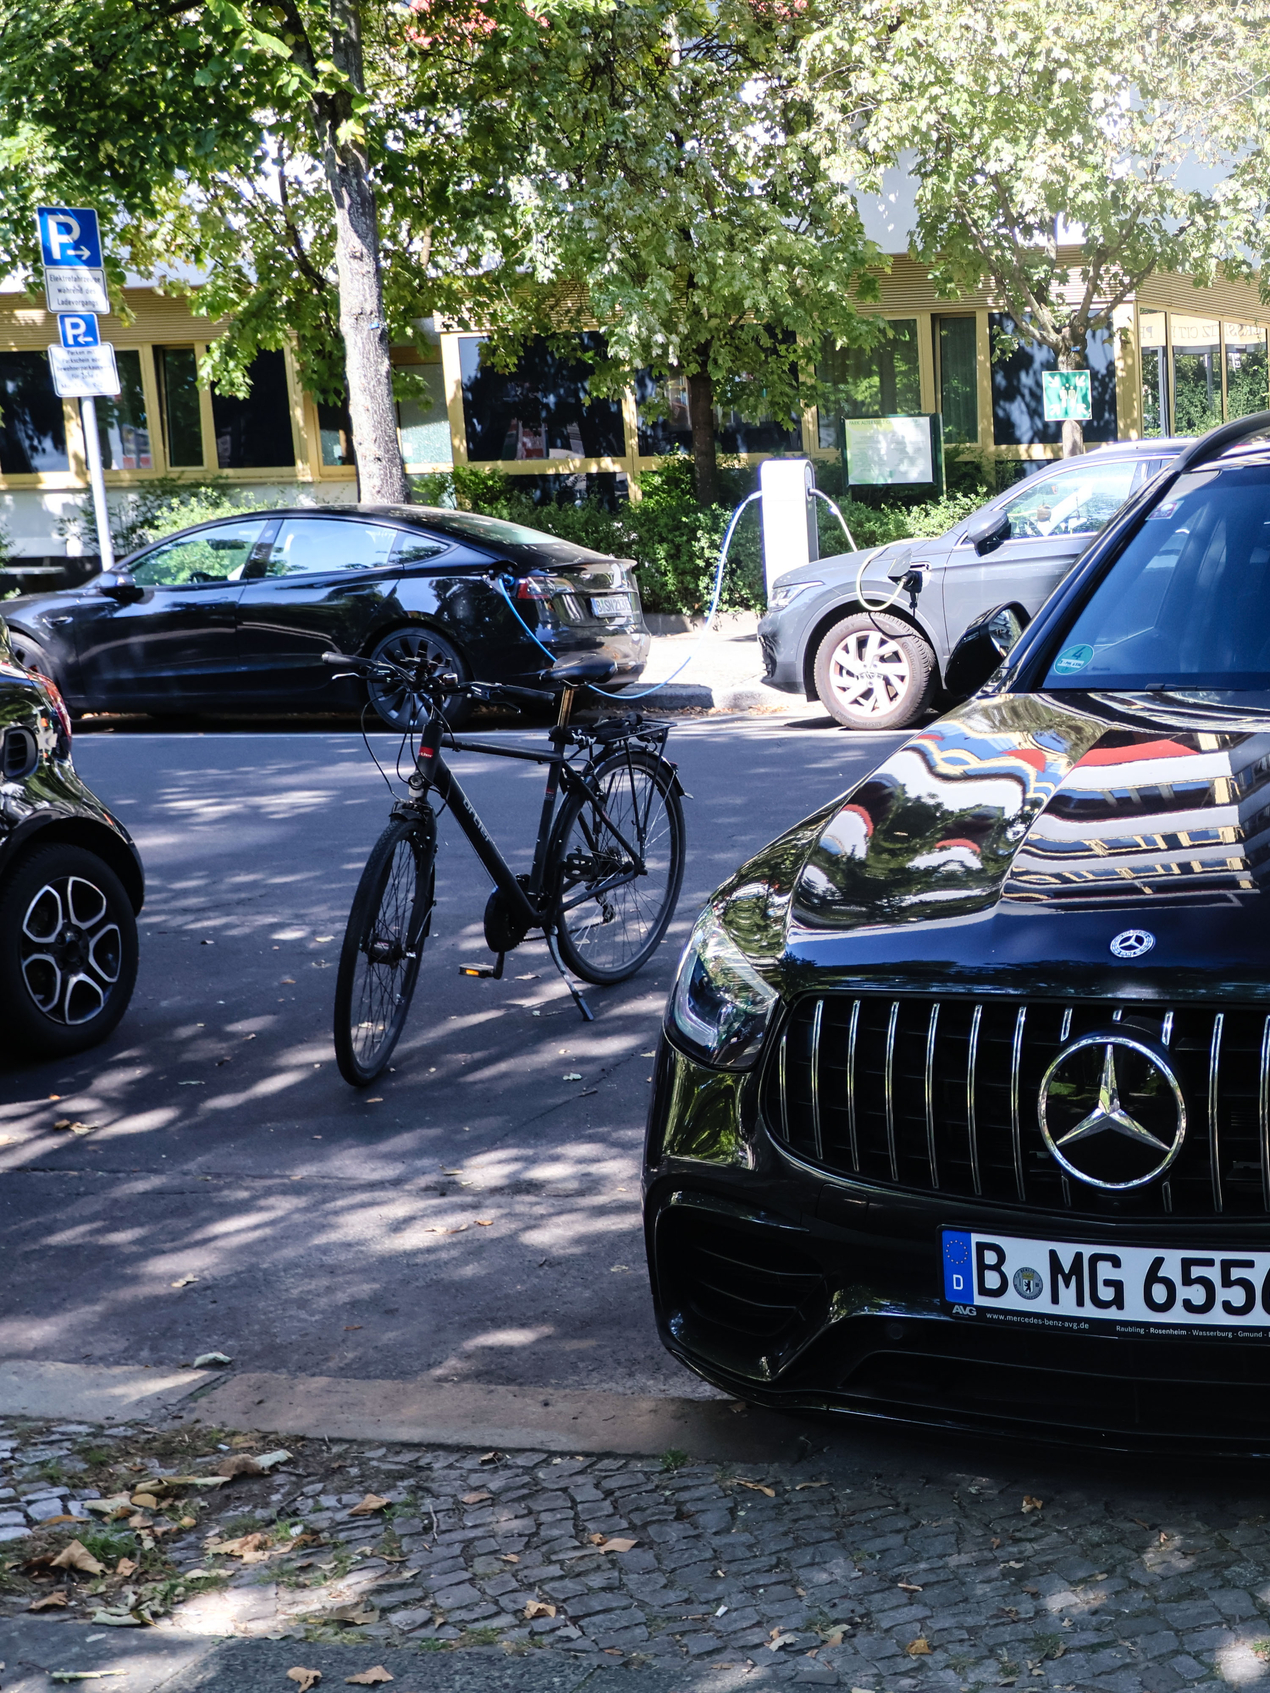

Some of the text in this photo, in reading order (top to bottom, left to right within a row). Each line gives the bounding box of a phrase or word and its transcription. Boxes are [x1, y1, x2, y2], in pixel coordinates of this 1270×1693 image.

[48, 215, 80, 260] P
[57, 298, 99, 308] Ladevorgangs
[64, 317, 86, 345] P
[1071, 646, 1087, 660] 4
[952, 1274, 964, 1290] D
[975, 1241, 1009, 1298] B
[1049, 1248, 1125, 1311] MG
[952, 1304, 977, 1317] AVG
[986, 1311, 1090, 1330] www.mercedes-benz-avg.de
[1116, 1325, 1145, 1335] Raubling
[1150, 1327, 1187, 1336] Rosenheim
[1192, 1329, 1233, 1338] Wasserburg
[1238, 1330, 1263, 1338] Gmund
